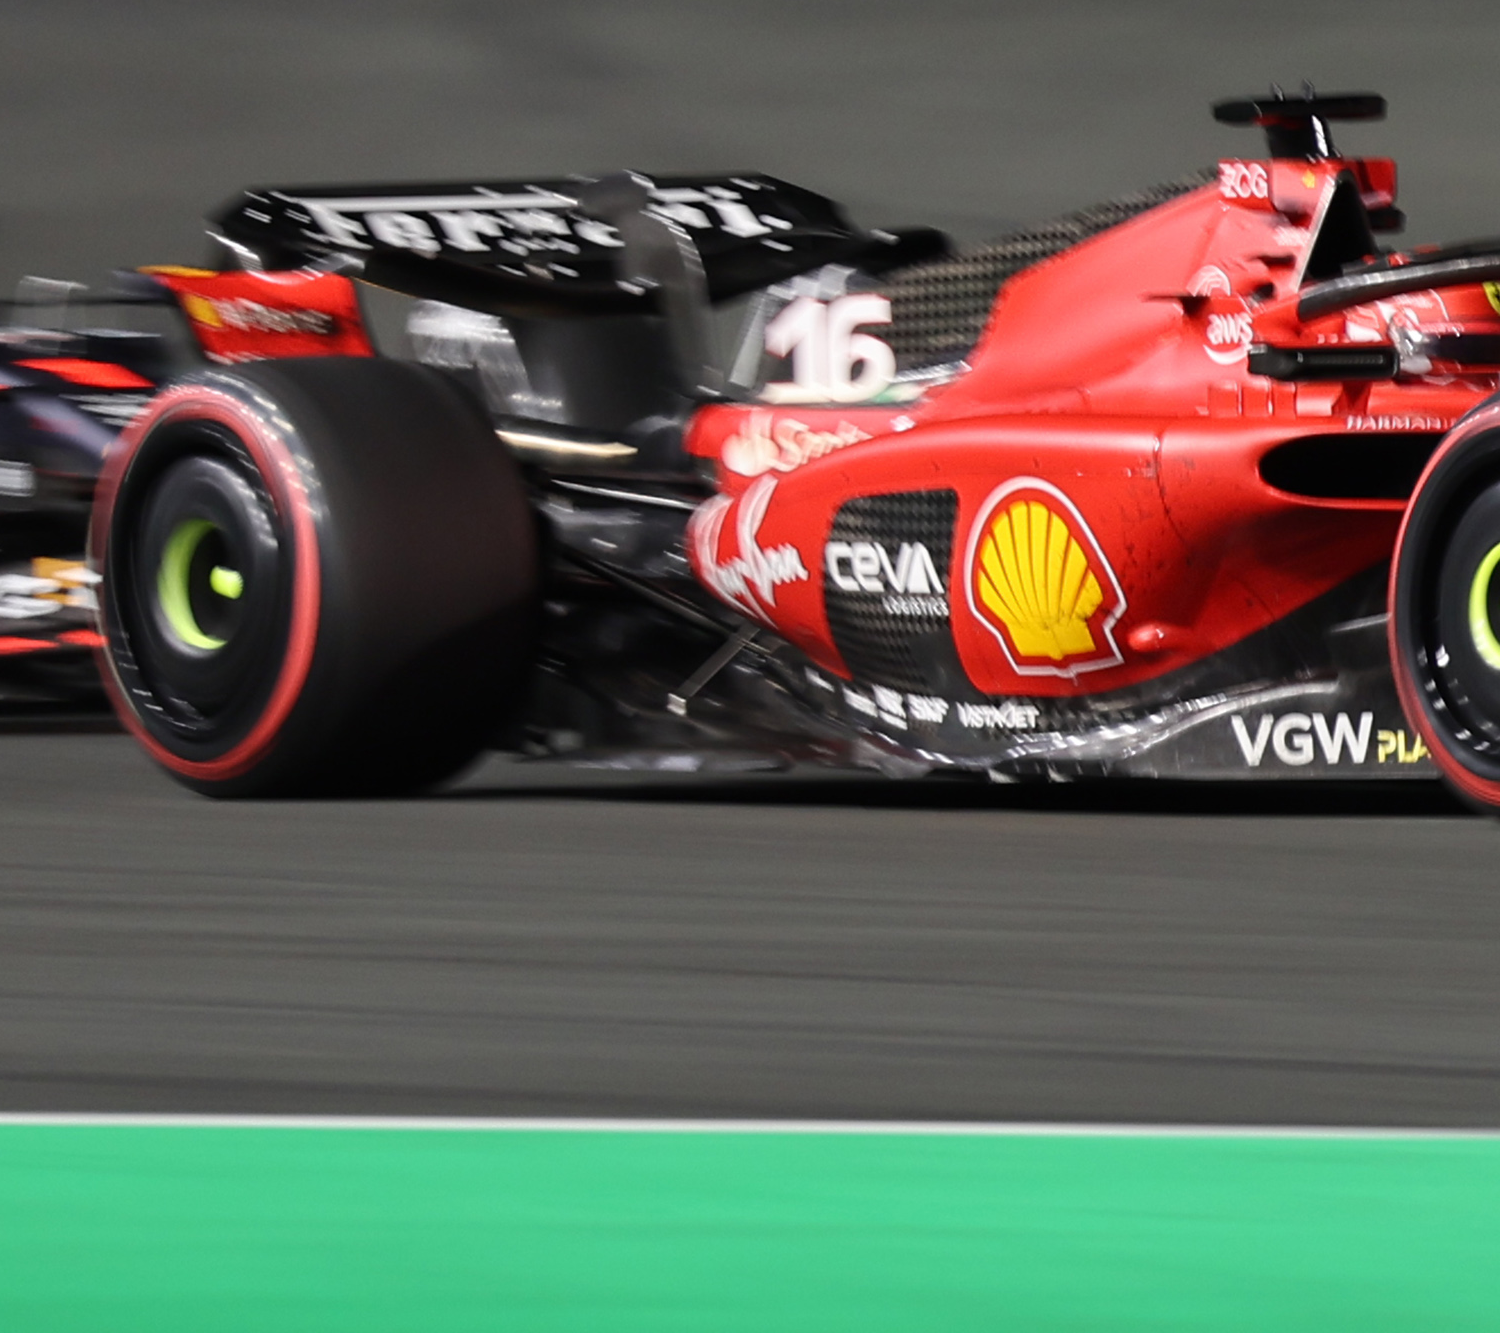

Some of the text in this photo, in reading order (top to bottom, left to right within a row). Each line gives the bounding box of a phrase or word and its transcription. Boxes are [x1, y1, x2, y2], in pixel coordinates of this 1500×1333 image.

[765, 293, 896, 402] 16
[1206, 312, 1253, 345] aws
[882, 596, 950, 616] LOGISTICS
[1231, 711, 1373, 766] VGW
